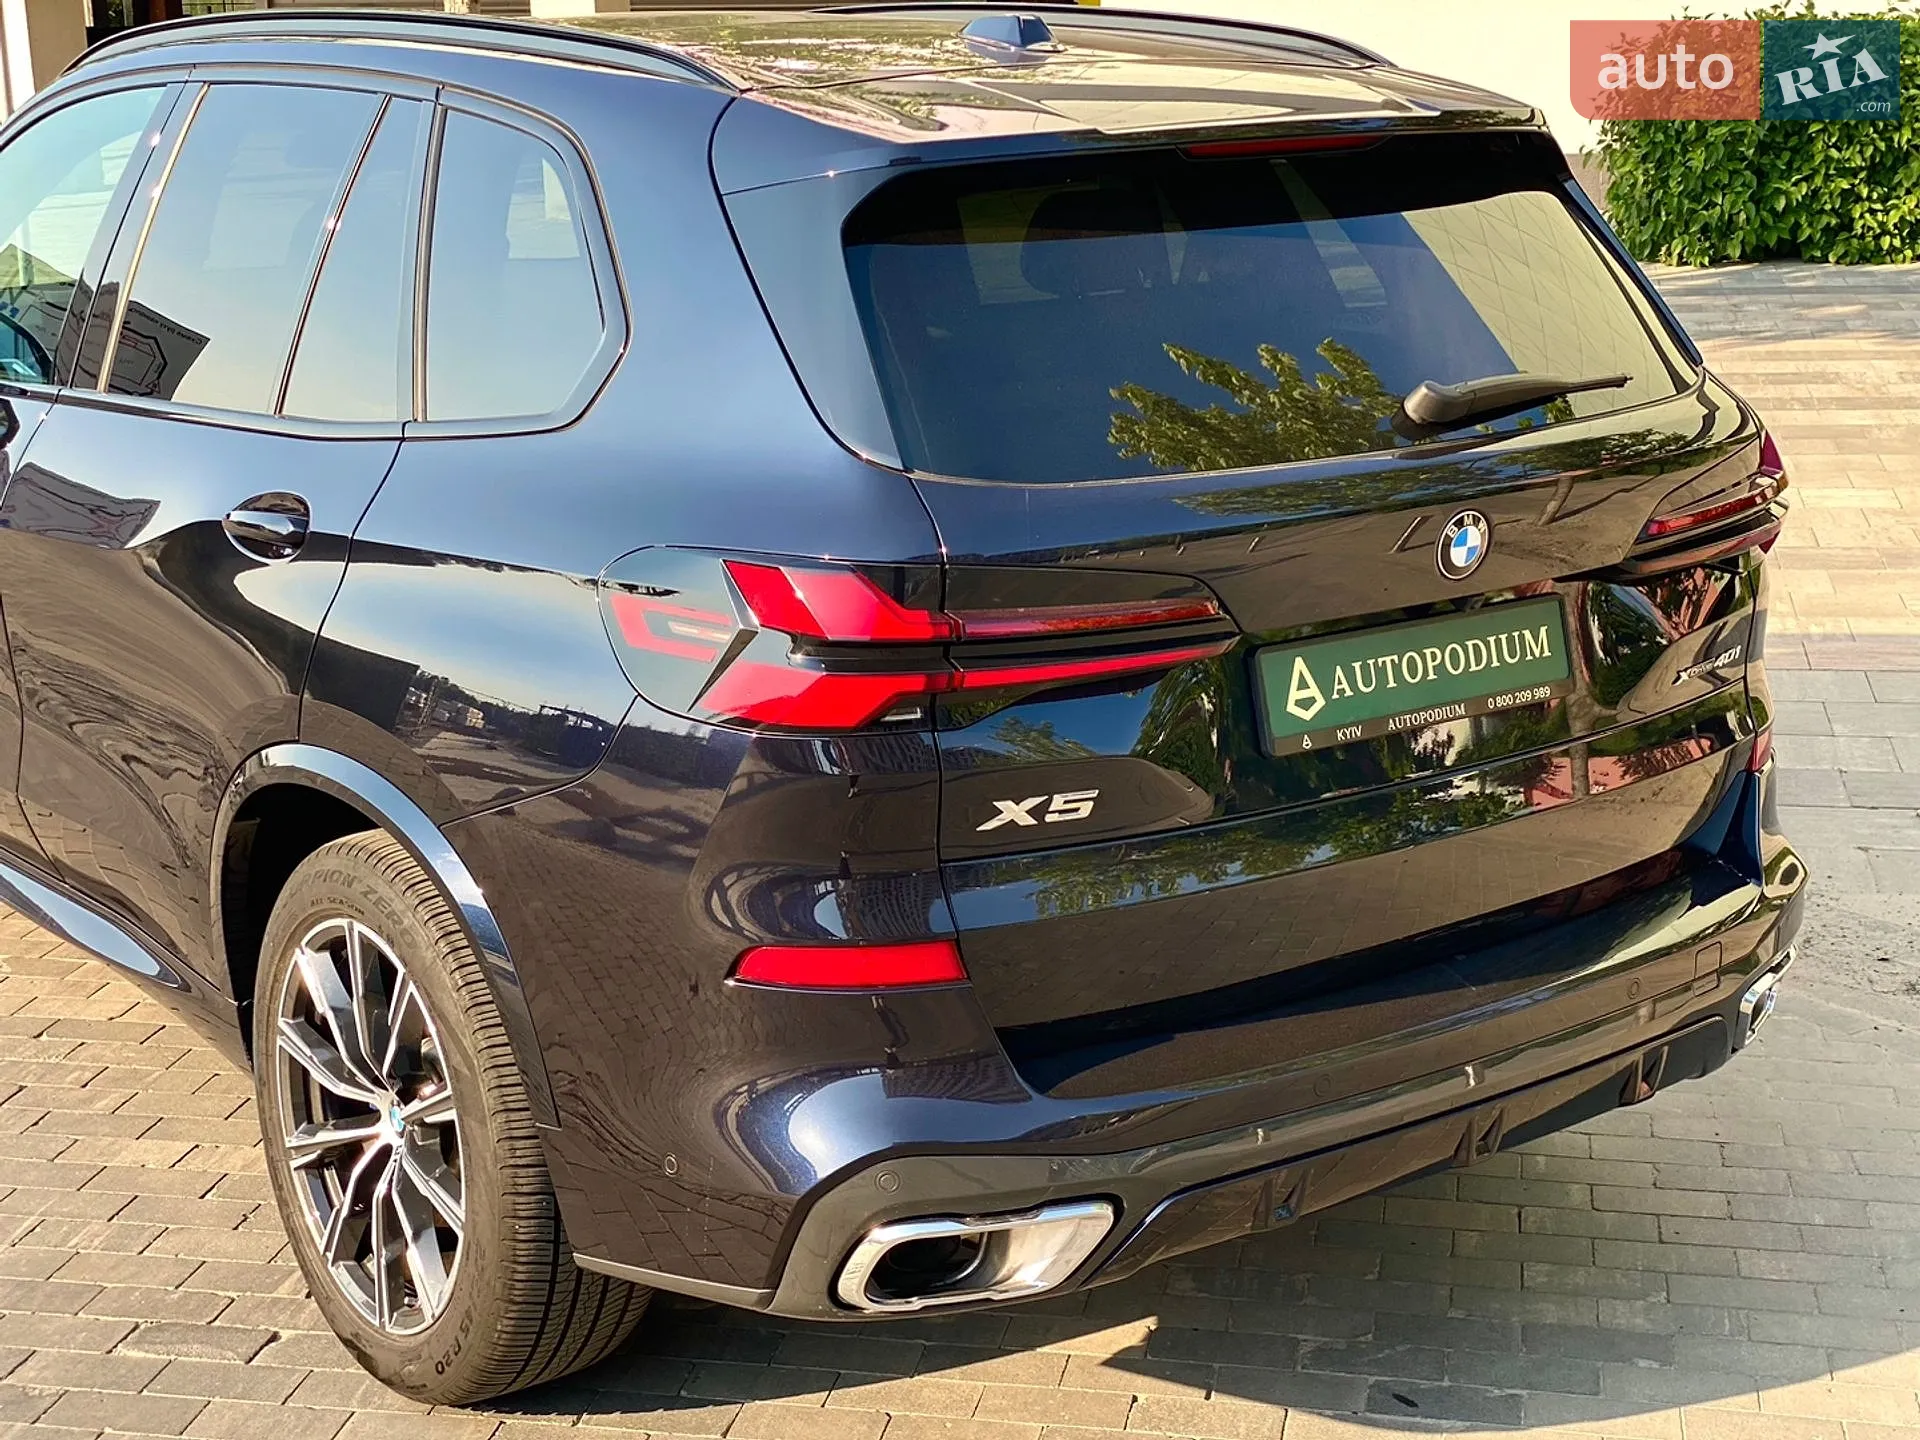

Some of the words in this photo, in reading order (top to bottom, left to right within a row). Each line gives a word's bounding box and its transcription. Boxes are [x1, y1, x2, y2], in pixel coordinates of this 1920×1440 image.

[1447, 513, 1486, 538] BMW
[1331, 625, 1552, 699] AUTOPODIUM
[1336, 725, 1362, 741] KYIV
[1388, 703, 1466, 731] AUTOPODIUM
[1487, 697, 1495, 709] 0
[1496, 694, 1513, 707] 800
[1514, 690, 1532, 703] 209
[1533, 686, 1551, 699] 989
[975, 789, 1099, 831] X5
[359, 884, 419, 950] ZERO
